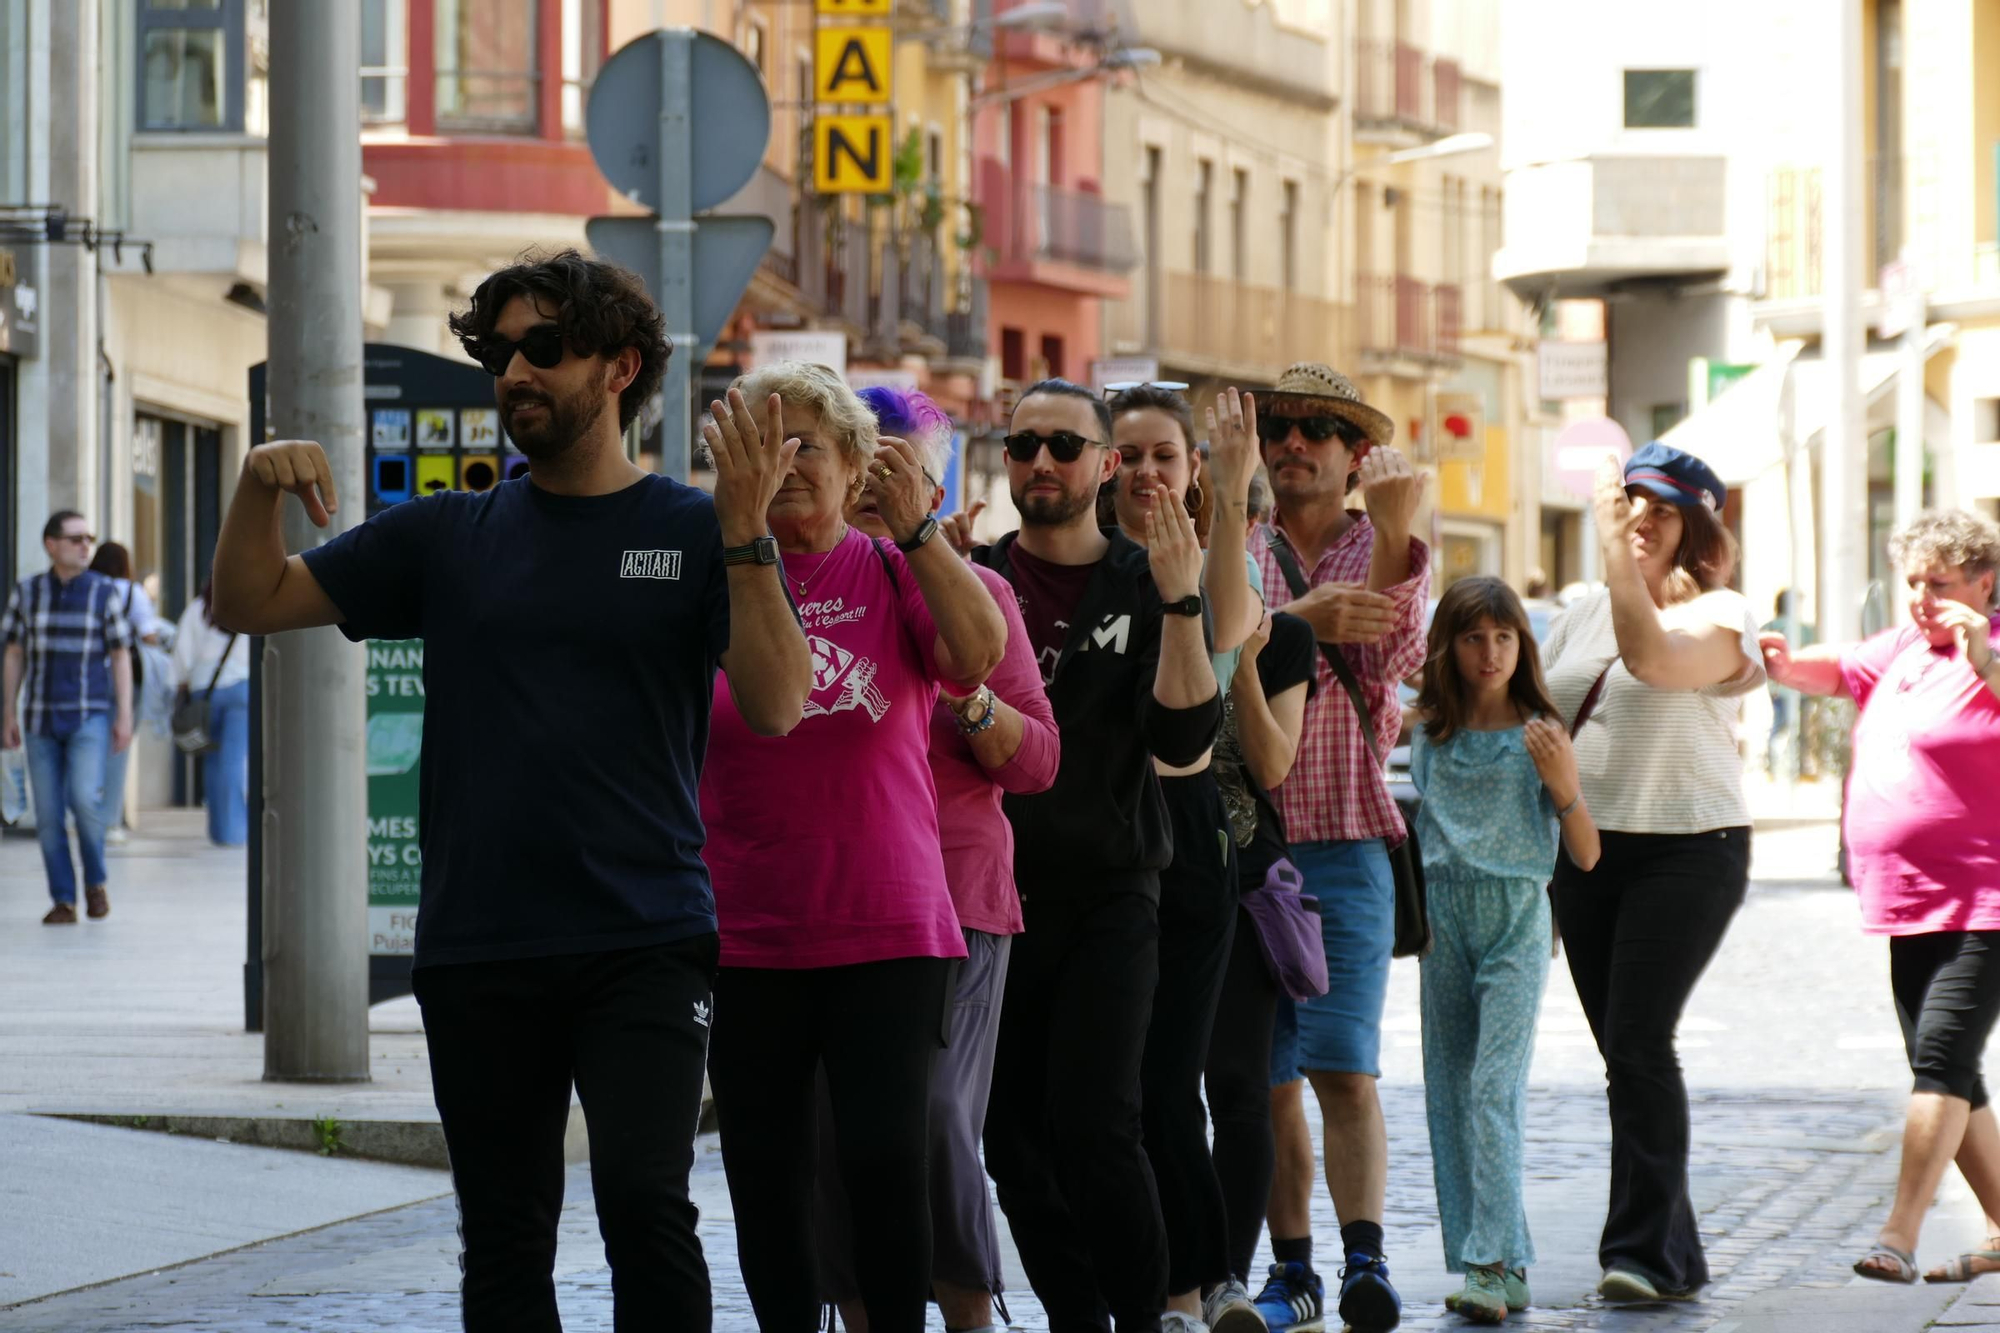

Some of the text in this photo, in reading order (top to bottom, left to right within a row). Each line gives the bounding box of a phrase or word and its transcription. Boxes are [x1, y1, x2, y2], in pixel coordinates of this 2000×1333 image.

[623, 552, 680, 577] AGITART
[367, 817, 416, 839] MES
[402, 844, 422, 866] C
